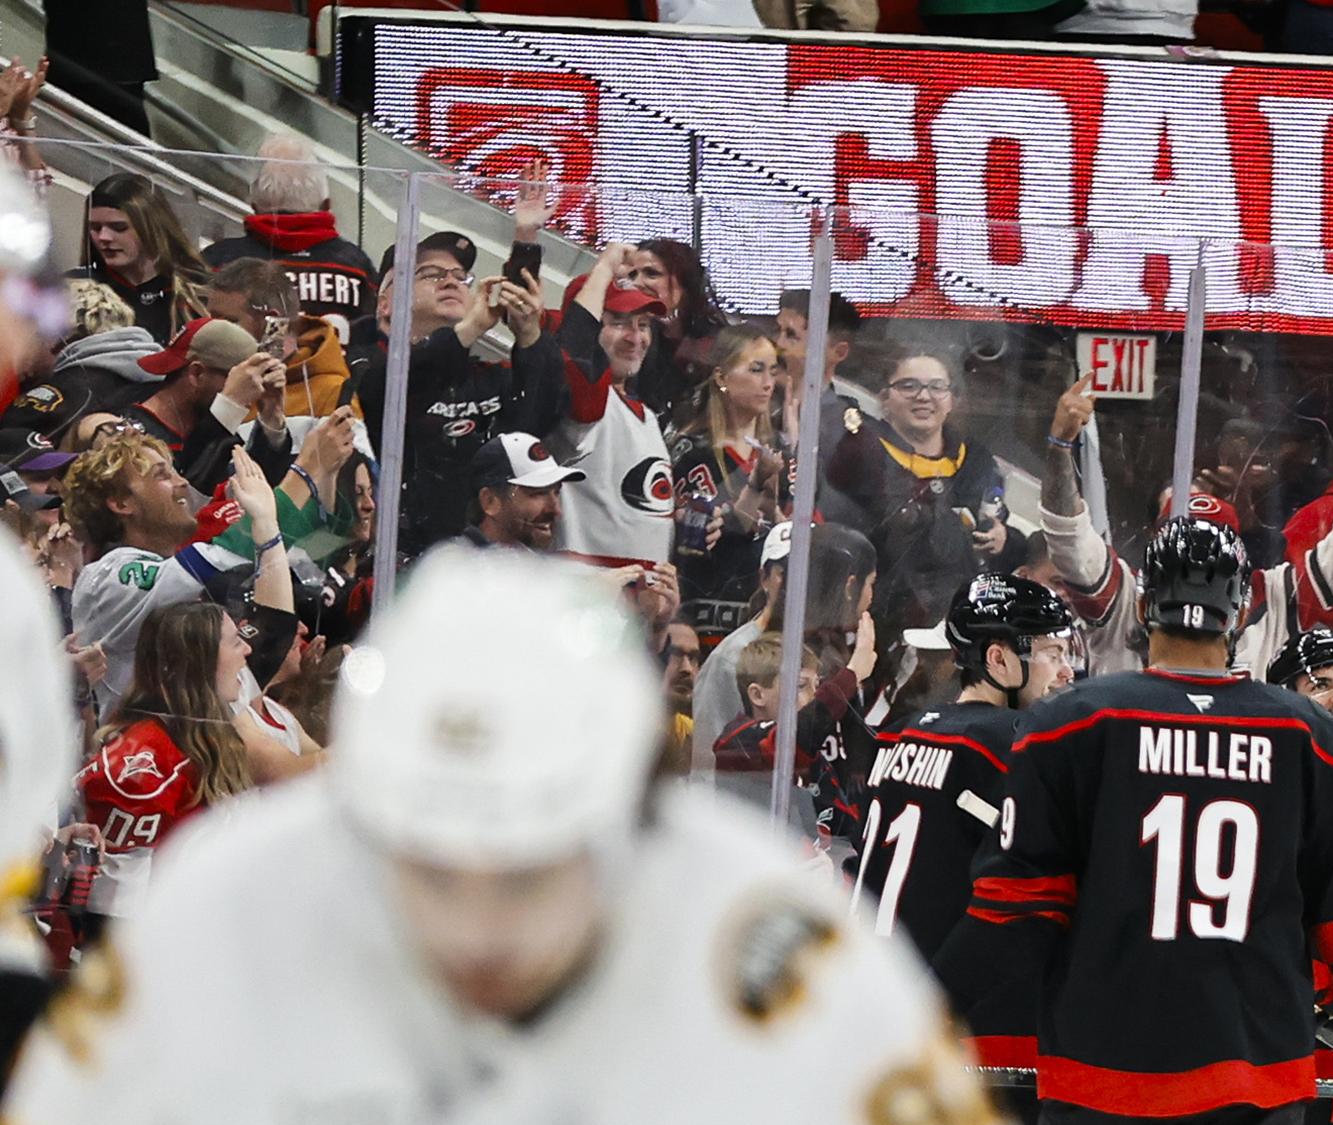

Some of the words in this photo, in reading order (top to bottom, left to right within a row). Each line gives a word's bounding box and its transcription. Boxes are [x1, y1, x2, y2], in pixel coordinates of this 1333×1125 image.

[1091, 338, 1149, 392] EXIT
[1183, 604, 1204, 628] 19
[1138, 727, 1272, 784] MILLER
[1142, 794, 1259, 943] 19
